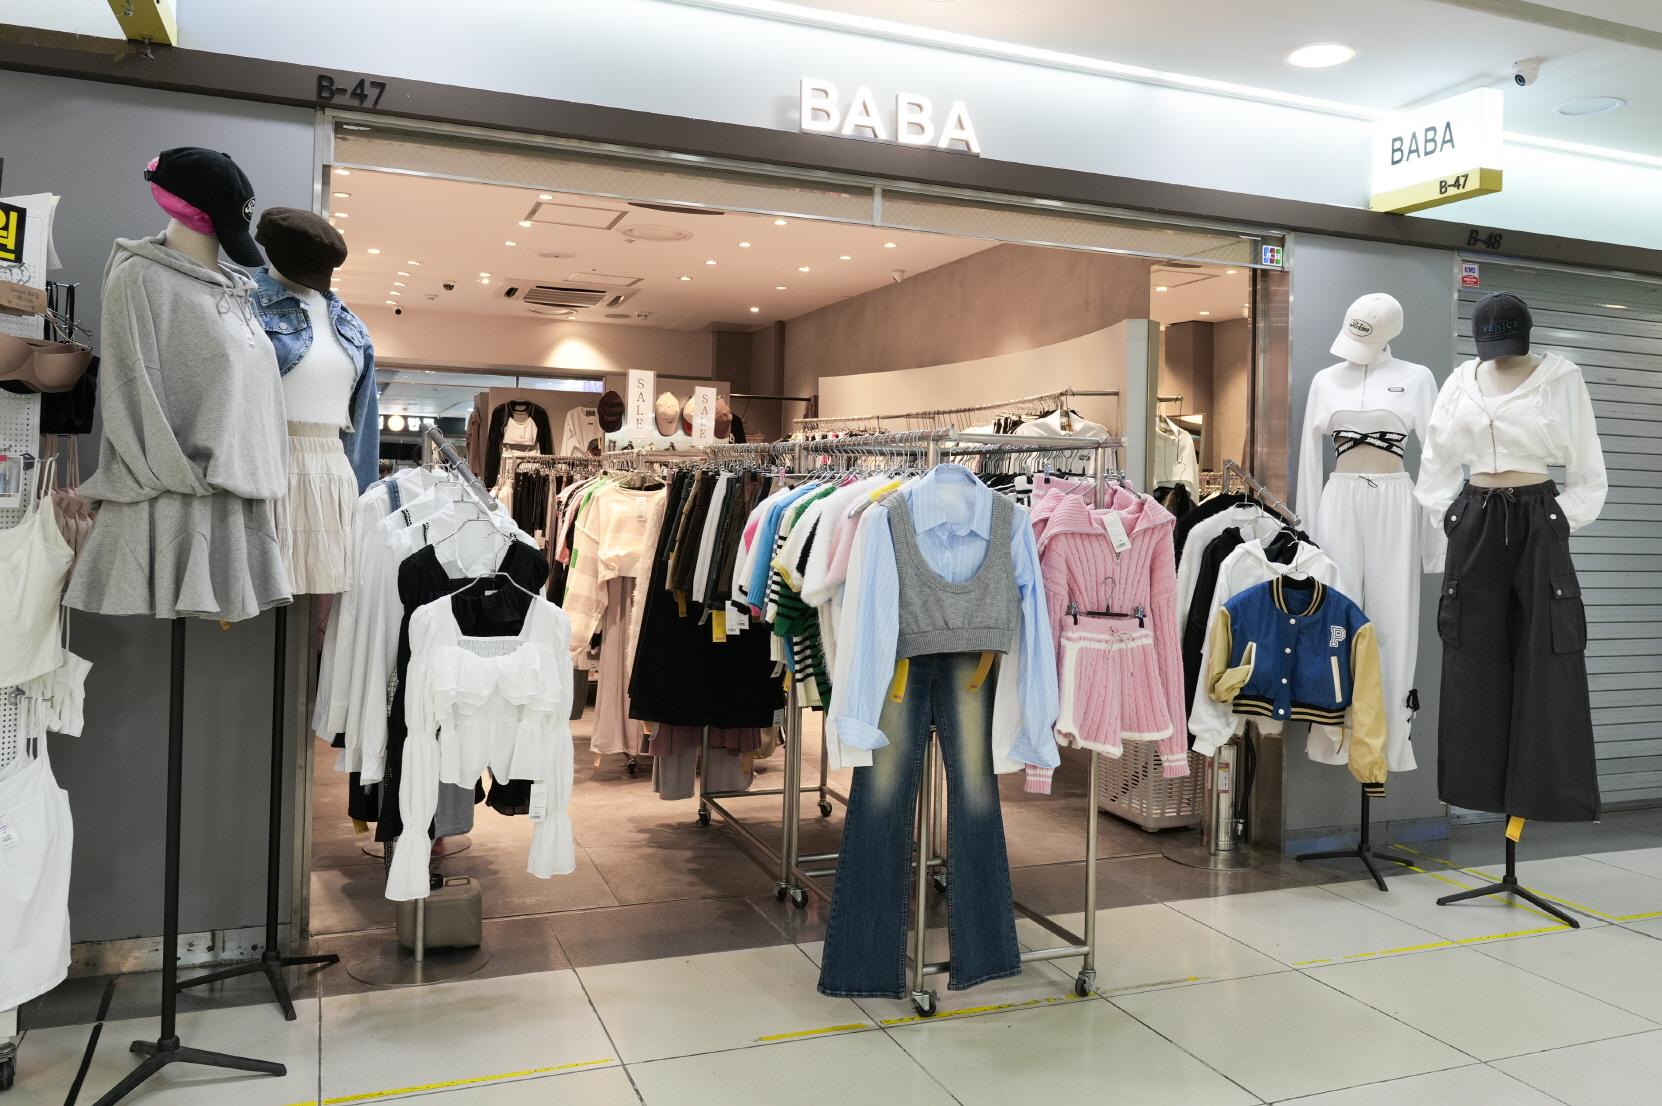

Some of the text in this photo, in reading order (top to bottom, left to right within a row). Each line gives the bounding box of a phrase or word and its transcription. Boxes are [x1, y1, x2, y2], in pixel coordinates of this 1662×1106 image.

[317, 74, 387, 109] B-47
[800, 76, 982, 156] BABA
[1391, 121, 1455, 166] BABA
[1439, 173, 1469, 195] B-47
[1467, 229, 1503, 250] B-48
[1482, 319, 1519, 332] VENICE
[636, 378, 646, 429] SALE
[700, 393, 709, 438] SALE
[1329, 625, 1347, 647] P
